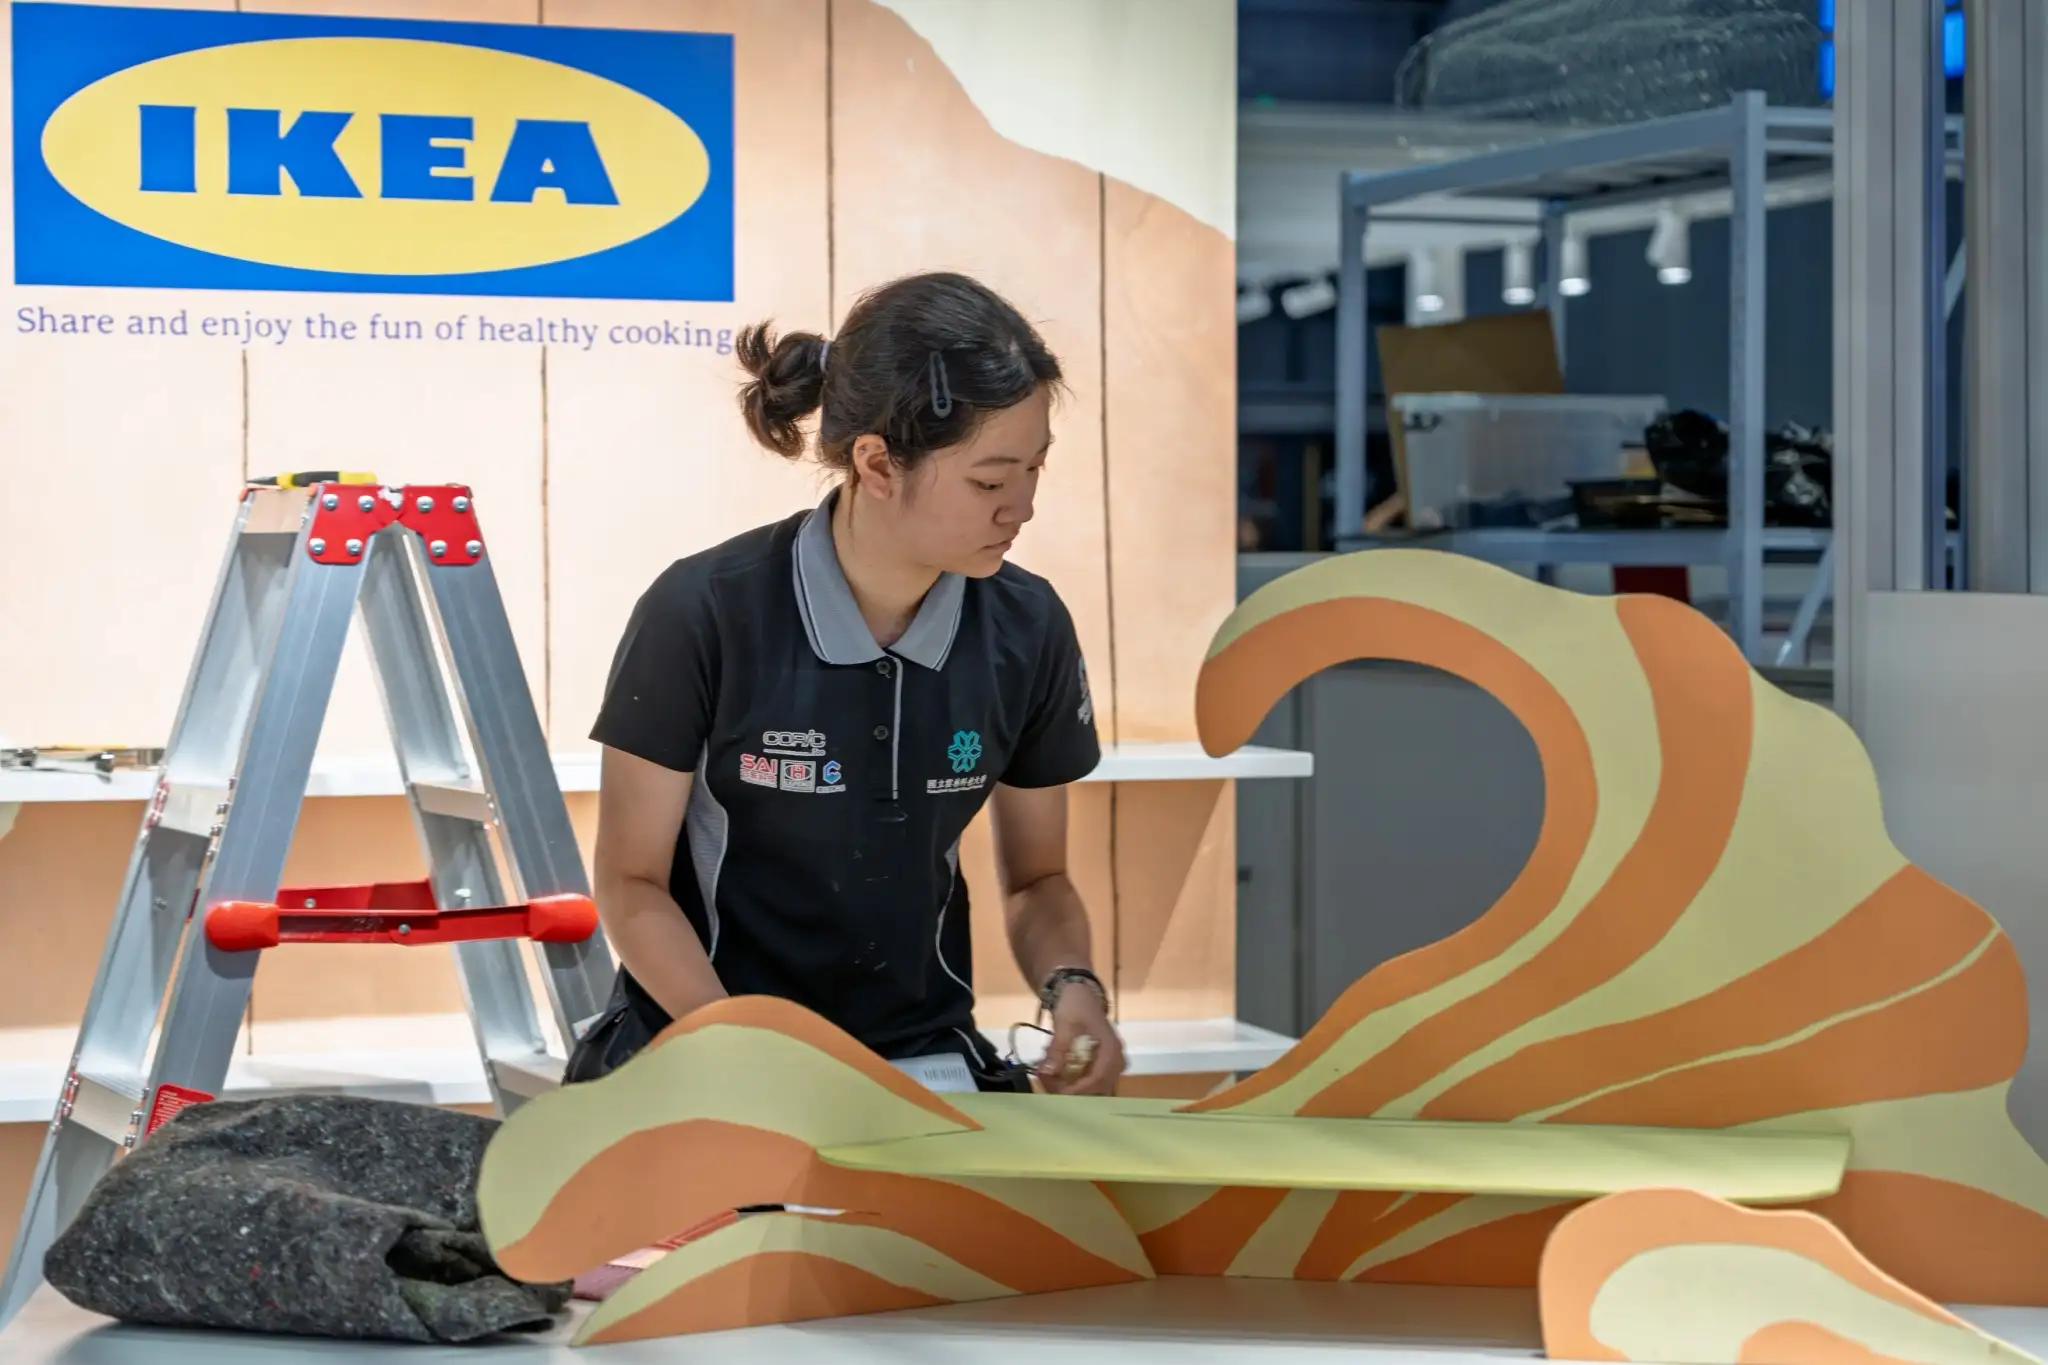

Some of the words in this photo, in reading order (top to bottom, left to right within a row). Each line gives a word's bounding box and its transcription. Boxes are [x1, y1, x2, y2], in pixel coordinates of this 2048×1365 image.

[138, 104, 620, 206] IKEA
[17, 306, 115, 334] Share
[127, 309, 188, 336] and
[201, 311, 292, 345] enjoy
[304, 313, 358, 340] the
[369, 313, 423, 340] fun
[435, 314, 468, 341] of
[478, 316, 598, 351] healthy
[608, 320, 732, 356] cooking
[740, 753, 779, 774] SAI
